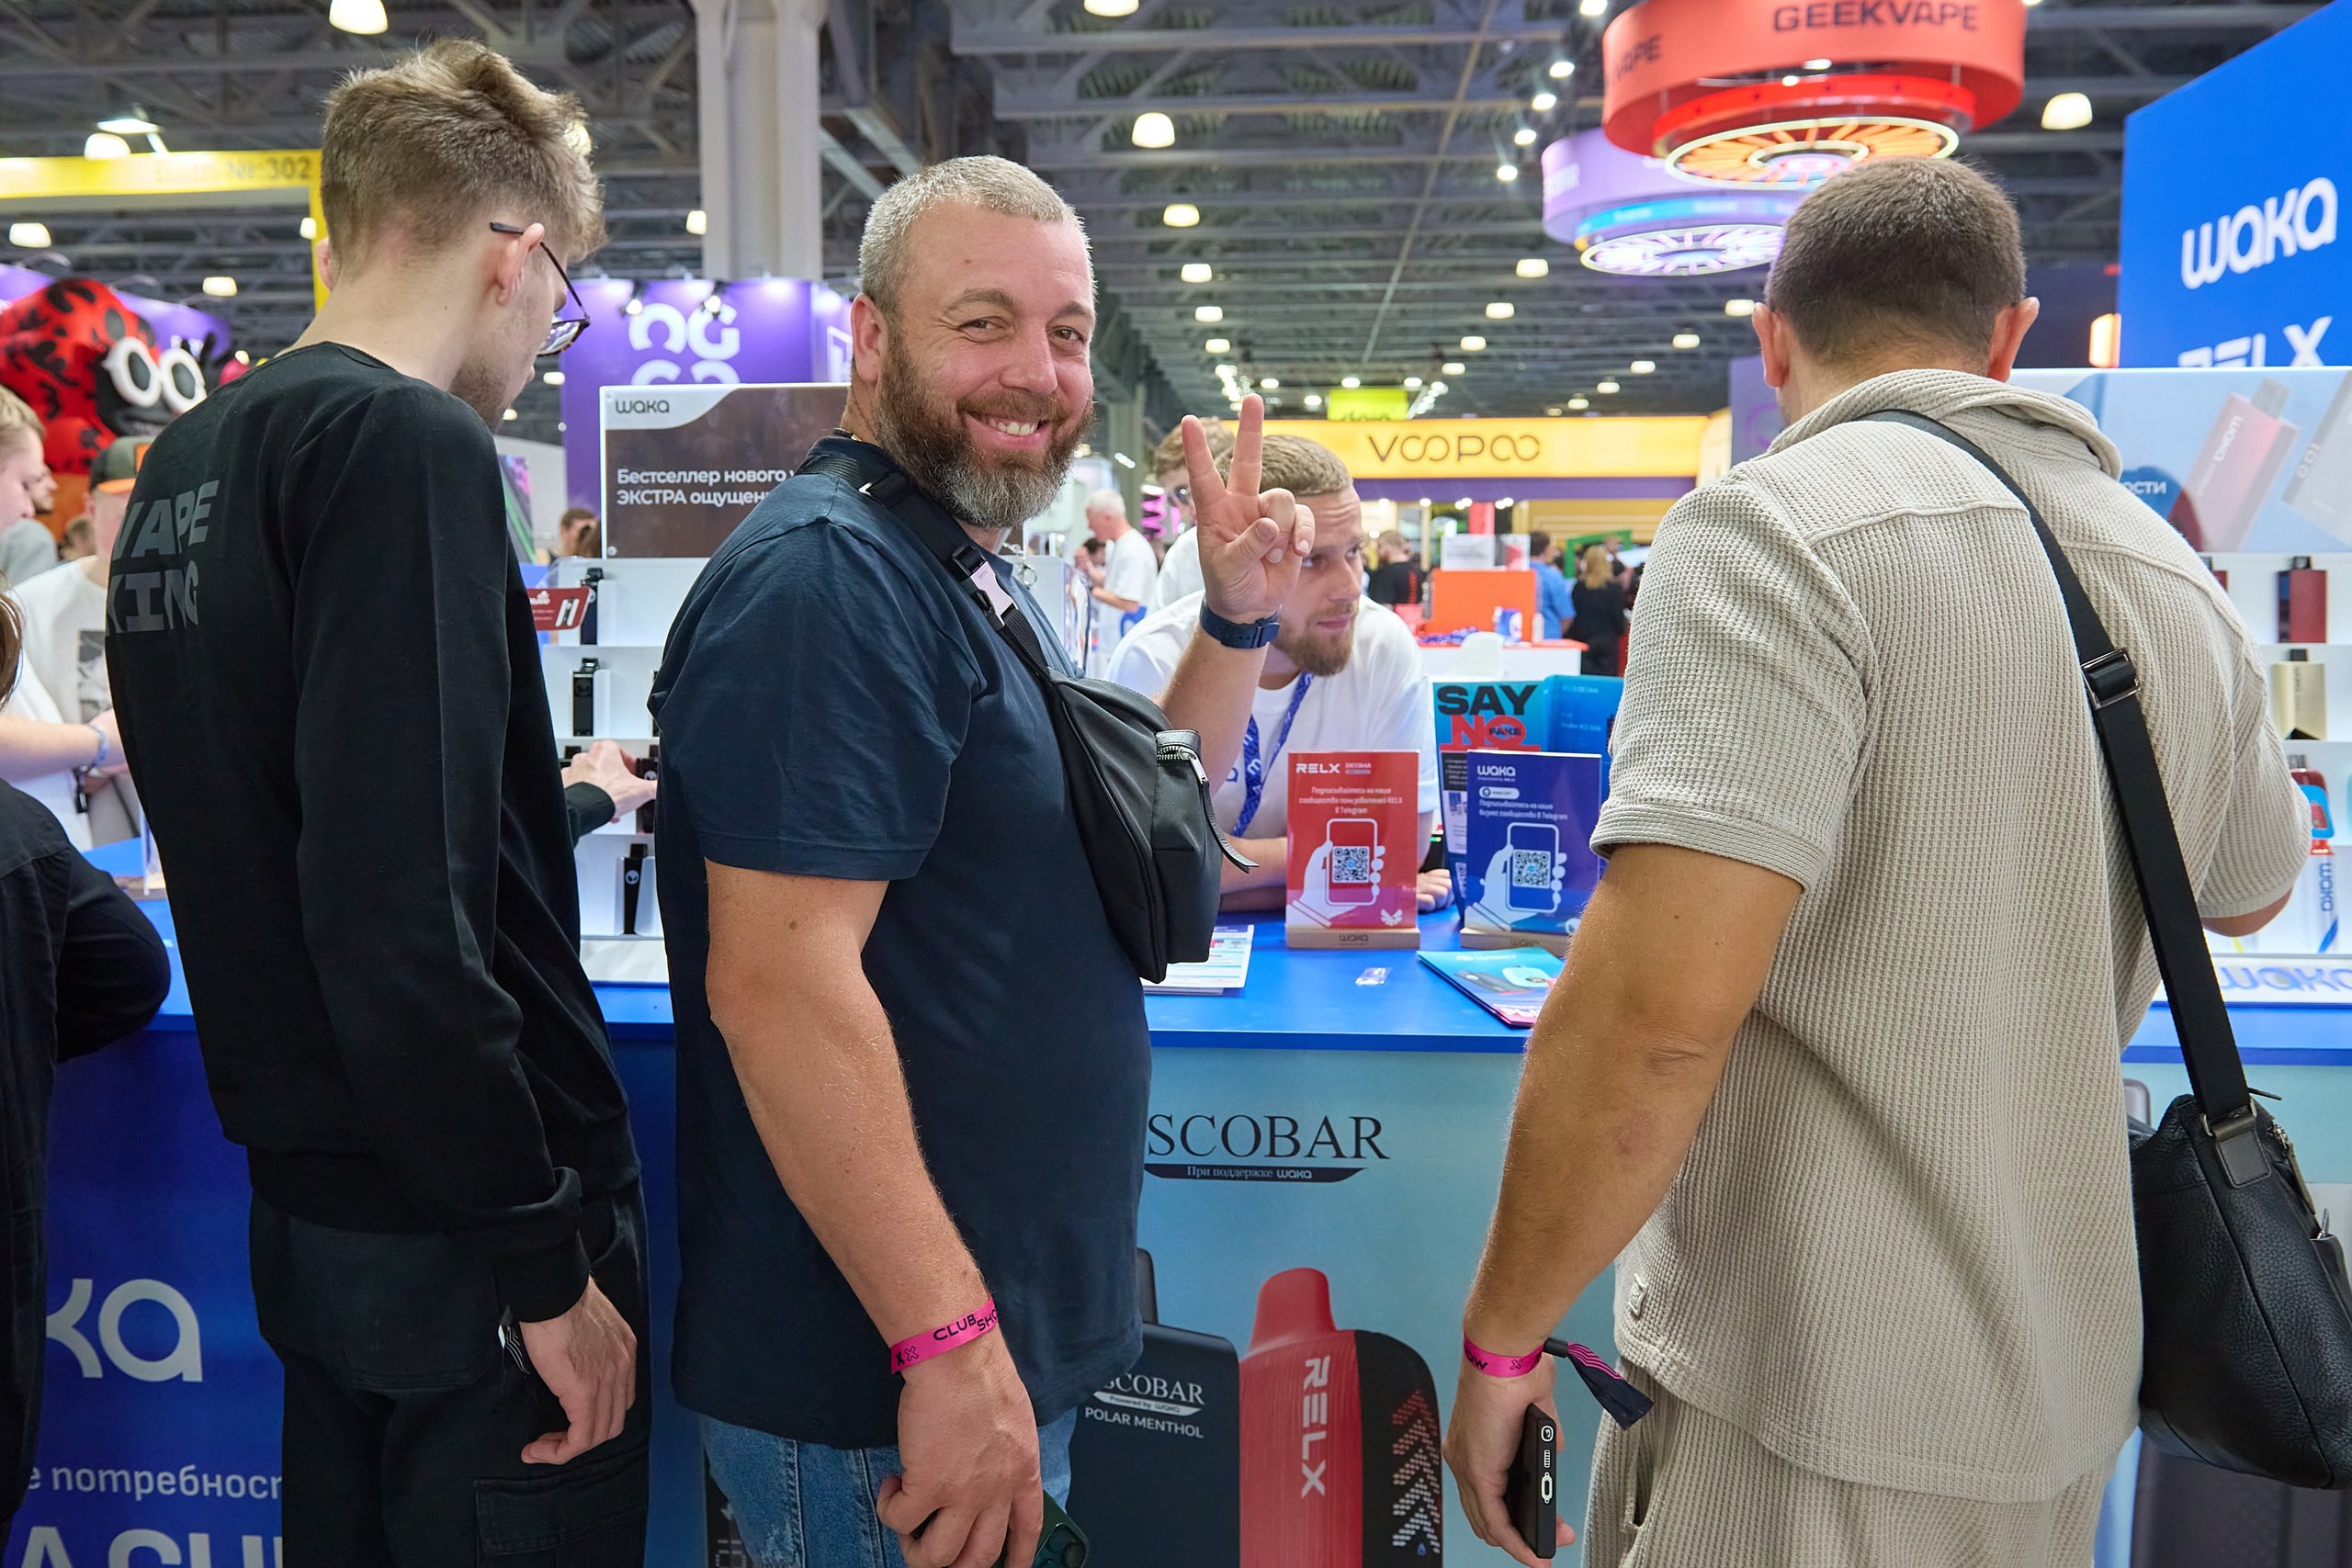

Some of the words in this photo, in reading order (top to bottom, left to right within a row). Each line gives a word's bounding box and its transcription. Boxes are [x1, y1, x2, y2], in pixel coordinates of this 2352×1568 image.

[1774, 0, 1978, 32] GEEKVAPE
[266, 156, 311, 181] 302
[2181, 176, 2338, 289] waka
[616, 400, 670, 413] waka
[1368, 434, 1540, 461] VOOPOO
[616, 468, 720, 487] Бестселлер
[724, 470, 786, 483] нового
[616, 490, 687, 505] ЭКСТРА
[690, 491, 768, 508] ощущен
[112, 480, 220, 560] VAPE
[106, 560, 199, 636] KING
[1437, 685, 1538, 716] SAY
[1451, 715, 1527, 746] NO
[1488, 727, 1521, 737] FAKE
[1296, 763, 1340, 773] RELX
[1477, 765, 1516, 777] waka
[1340, 807, 1367, 815] Telegram
[2319, 863, 2334, 912] waka
[1148, 1114, 1391, 1159] SCOBAR
[1187, 1166, 1210, 1178] При
[1213, 1168, 1273, 1179] поддержке
[1276, 1169, 1312, 1179] waka
[933, 1314, 977, 1340] CLUB
[1109, 1395, 1140, 1407] Powered
[1085, 1406, 1131, 1426] POLAR
[1134, 1416, 1204, 1438] MENTHOL
[1301, 1355, 1330, 1499] RELX
